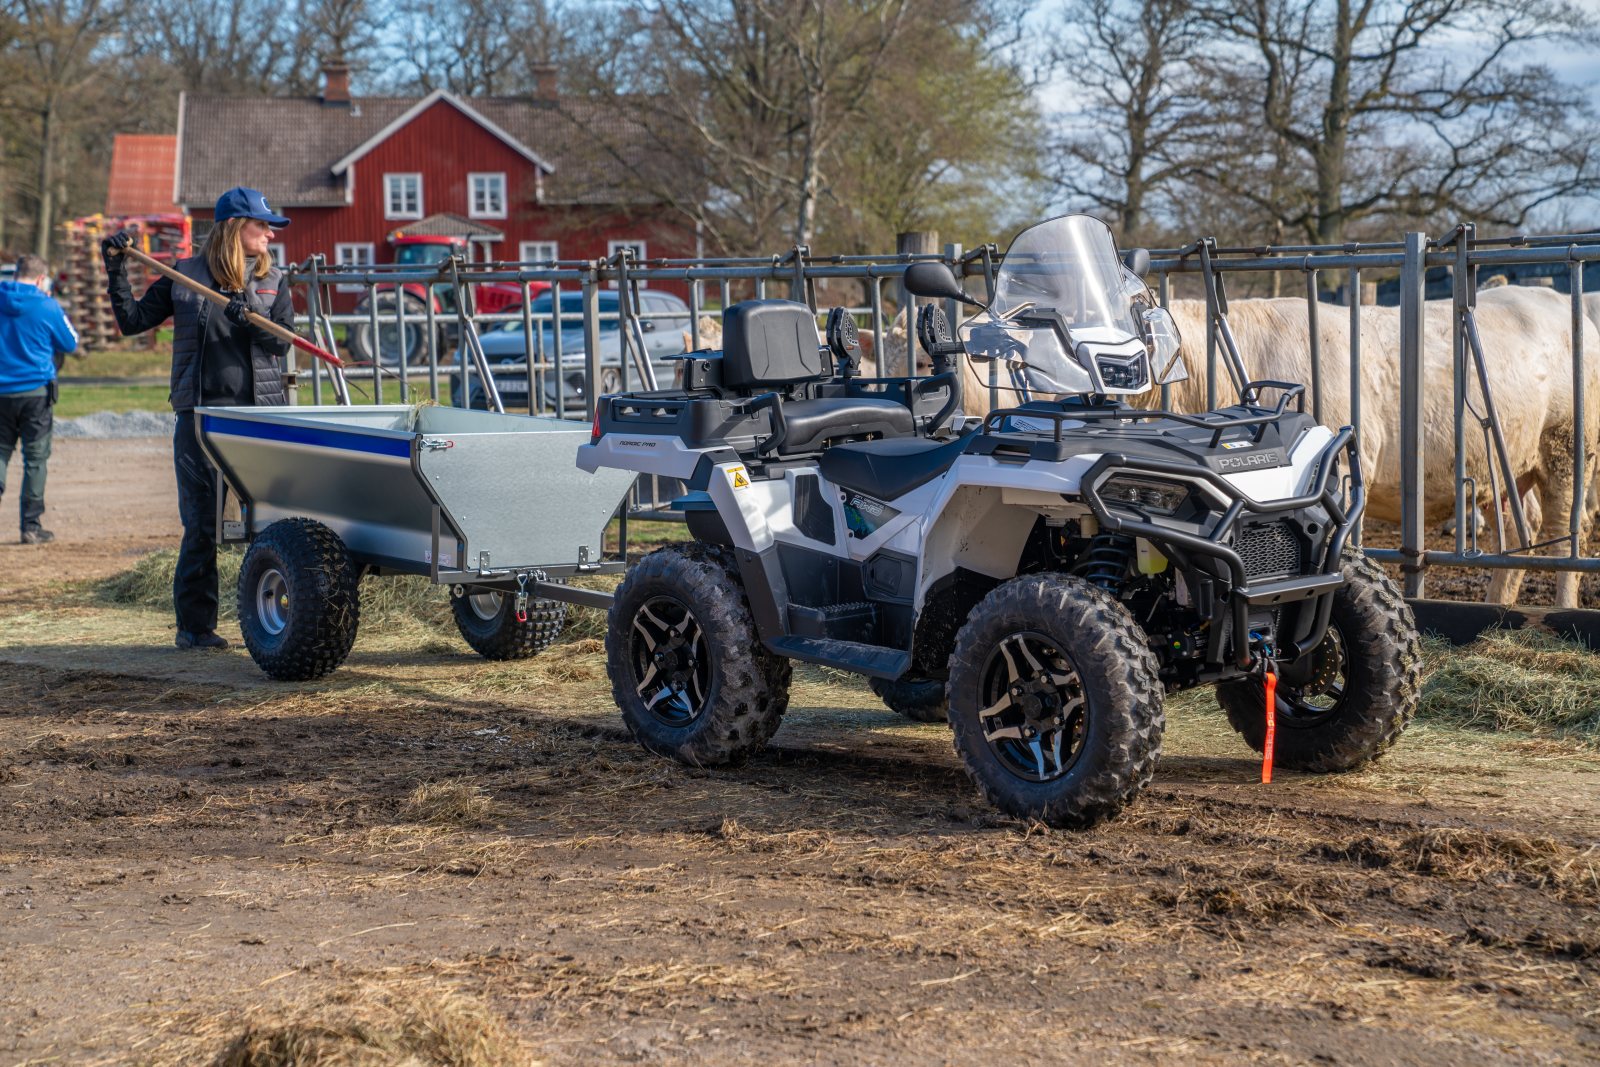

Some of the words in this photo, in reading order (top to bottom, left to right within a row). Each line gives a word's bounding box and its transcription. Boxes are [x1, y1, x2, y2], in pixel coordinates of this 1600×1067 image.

[1219, 453, 1279, 469] POLARIS
[849, 497, 883, 517] AWD
[1265, 711, 1275, 760] POLARIS
